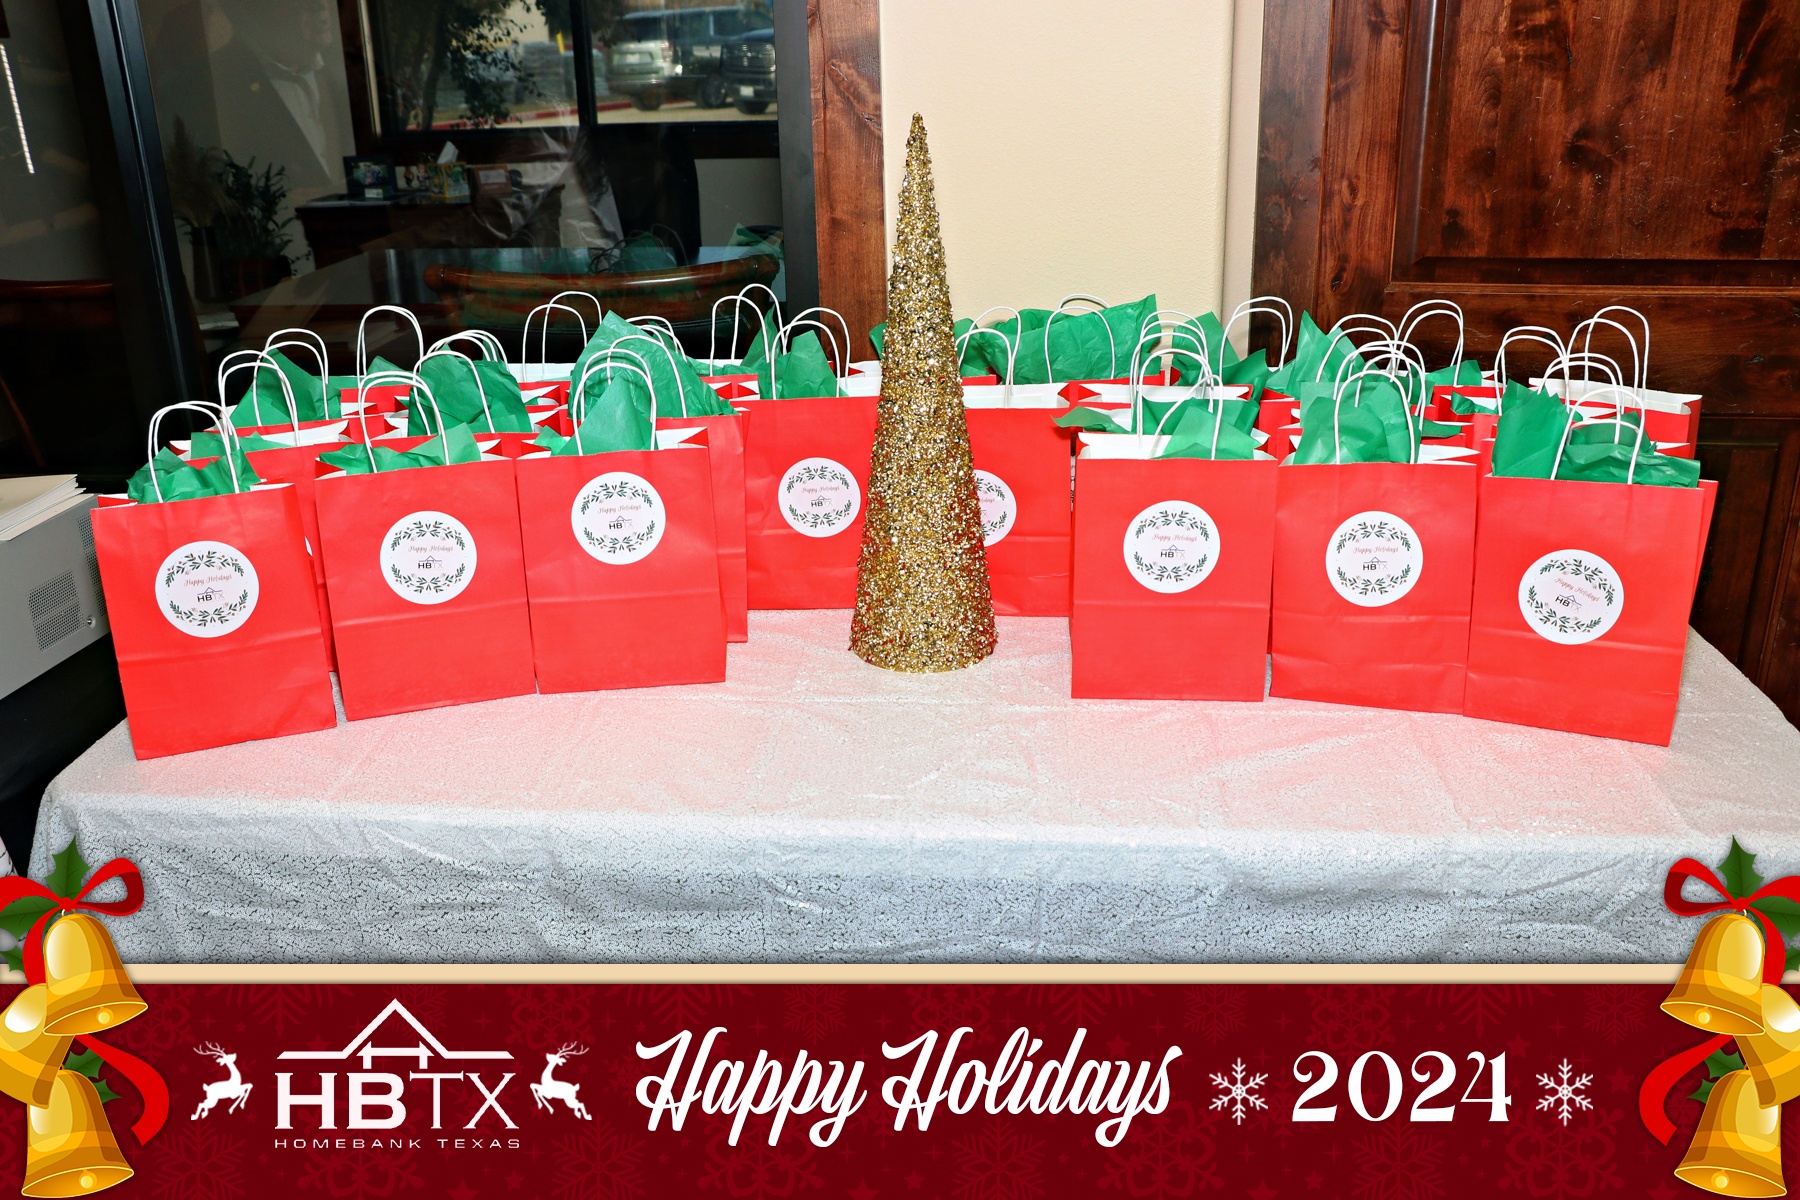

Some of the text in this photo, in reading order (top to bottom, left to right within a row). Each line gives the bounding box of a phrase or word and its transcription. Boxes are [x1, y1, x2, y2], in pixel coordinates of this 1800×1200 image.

[597, 506, 617, 514] Happy
[609, 521, 634, 530] HBTX
[1172, 534, 1197, 542] Holidays
[1353, 545, 1399, 554] Happy Holidays
[1363, 563, 1388, 571] HBTX
[184, 574, 232, 586] Happy Holidays
[1555, 577, 1600, 602] Happy Holidays
[197, 592, 224, 603] HBTX
[1555, 595, 1580, 612] HBTX
